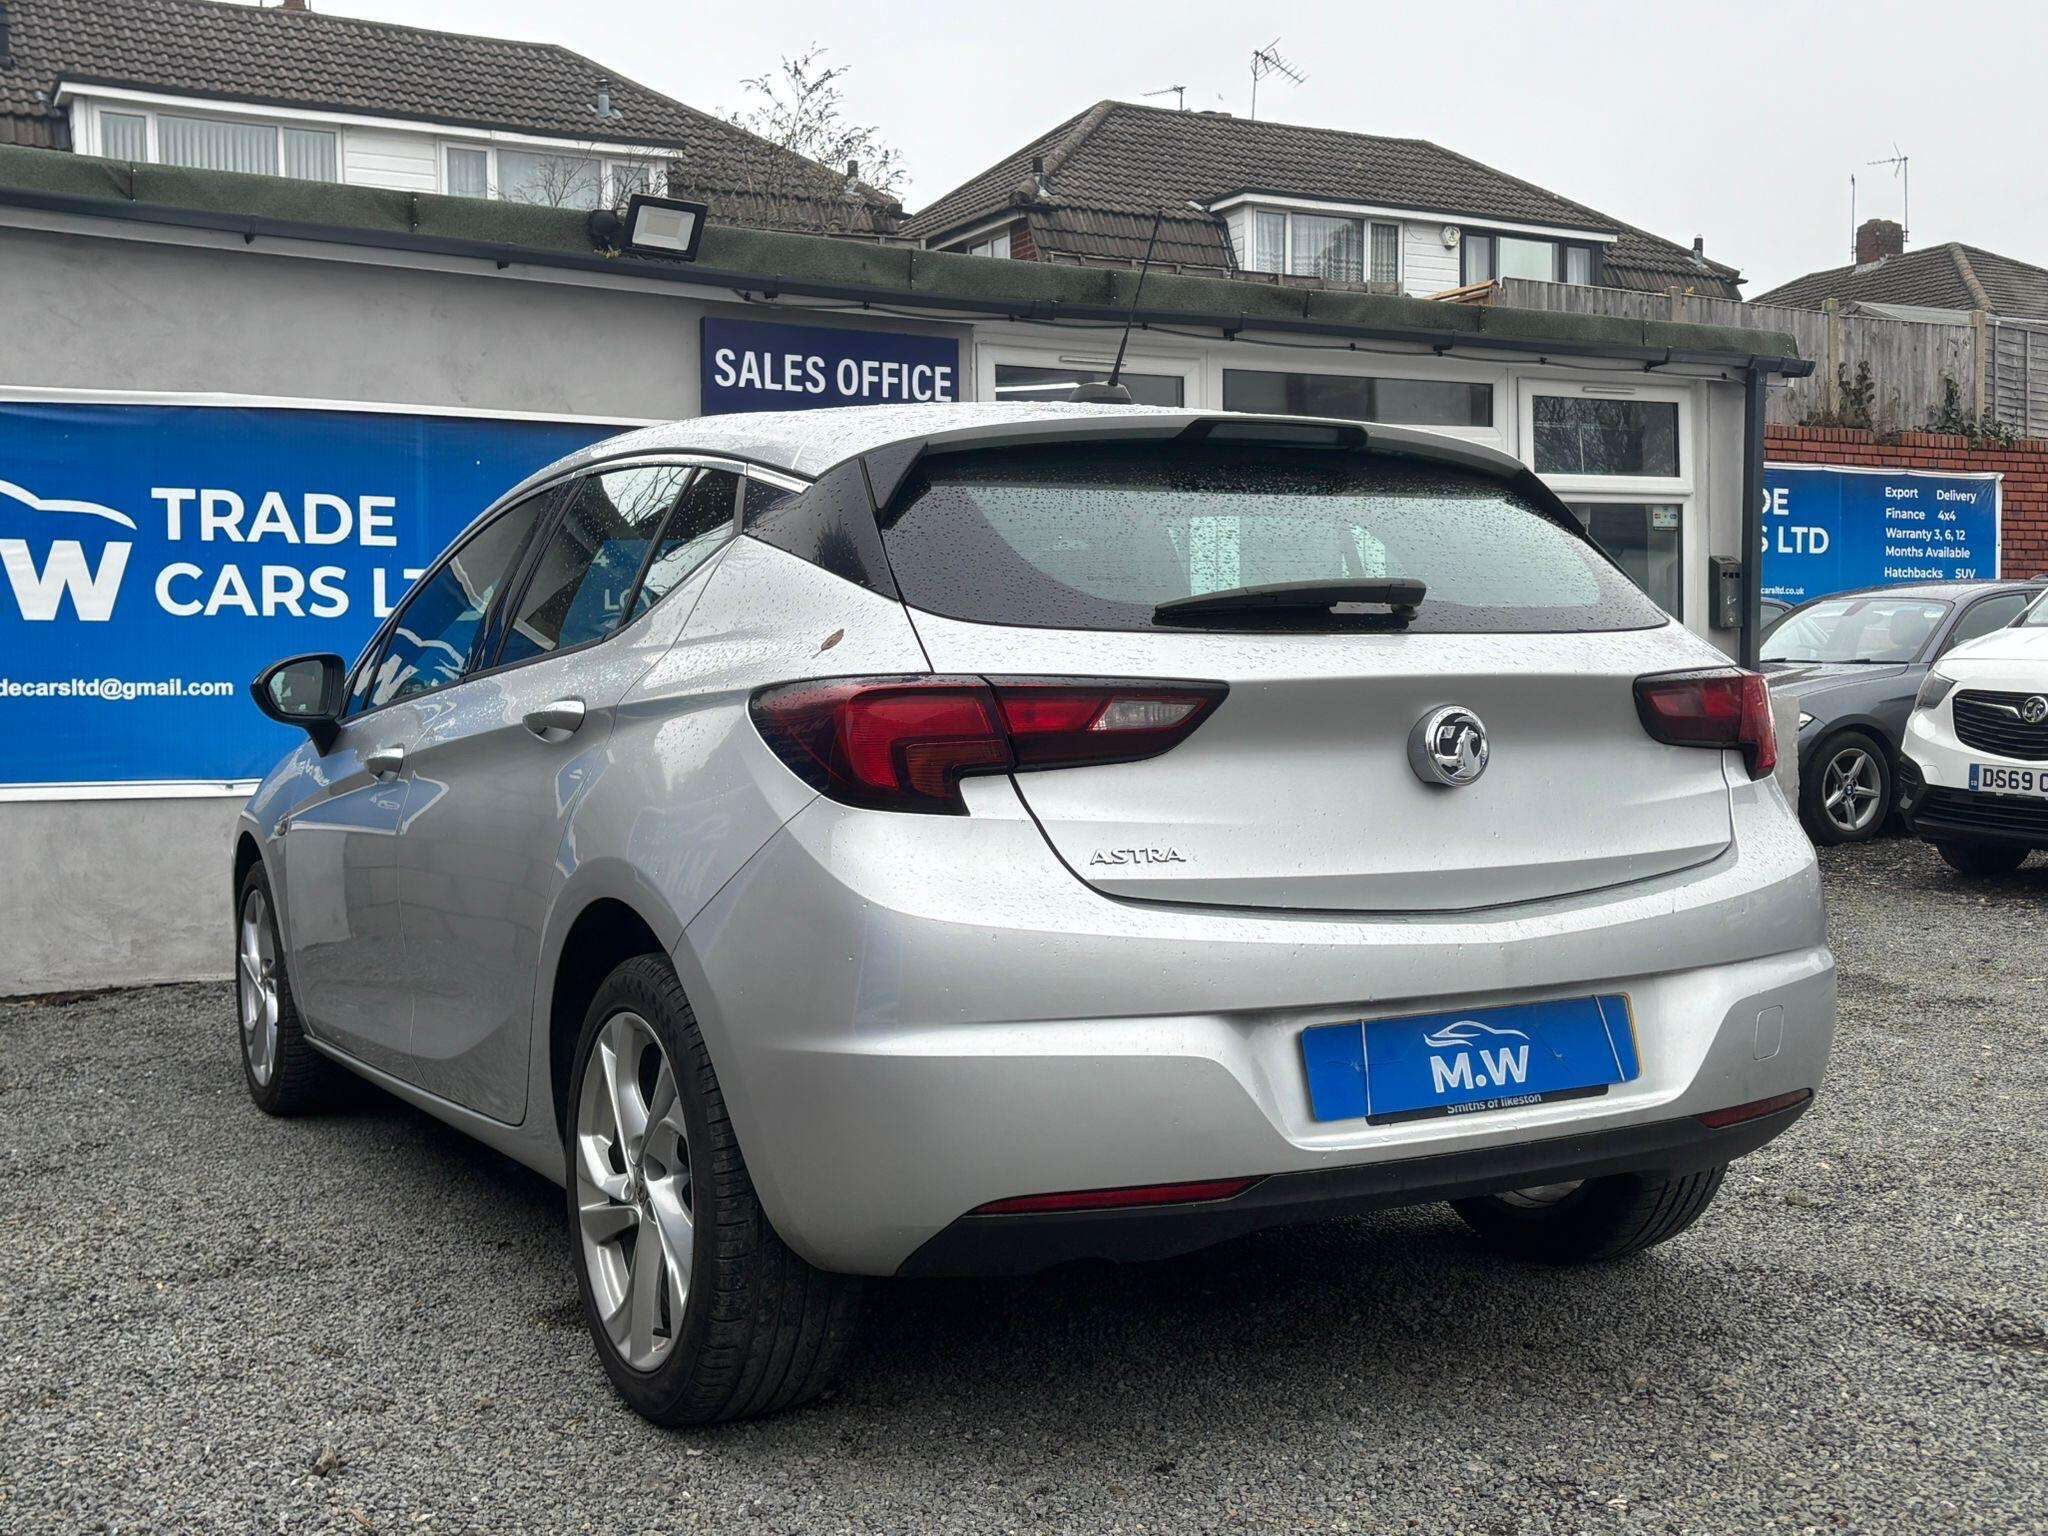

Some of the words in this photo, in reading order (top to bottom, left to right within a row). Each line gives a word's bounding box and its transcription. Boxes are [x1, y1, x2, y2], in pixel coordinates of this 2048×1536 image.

[714, 348, 827, 394] SALES
[836, 358, 952, 402] OFFICE
[1885, 486, 1919, 500] Export
[1936, 489, 1977, 504] Delivery
[151, 487, 397, 547] TRADE
[1885, 508, 1926, 521] Finance
[1937, 510, 1957, 522] 4x4
[1777, 525, 1830, 554] LTD
[1885, 528, 1932, 543] Warranty
[1934, 529, 1943, 543] 3,
[1944, 530, 1955, 543] 6,
[1955, 530, 1966, 542] 12
[1885, 546, 1923, 558] Months
[1926, 547, 1971, 560] Available
[0, 538, 132, 621] W
[1884, 567, 1943, 580] Hatchbacks
[1955, 568, 1976, 580] SUV
[155, 562, 350, 618] CARS
[373, 568, 424, 618] L
[0, 678, 234, 701] decarsltd@gmail.com
[1983, 768, 2033, 791] DS69
[1090, 848, 1186, 865] ASTRA
[1447, 1100, 1486, 1114] Smiths
[1487, 1098, 1499, 1109] of
